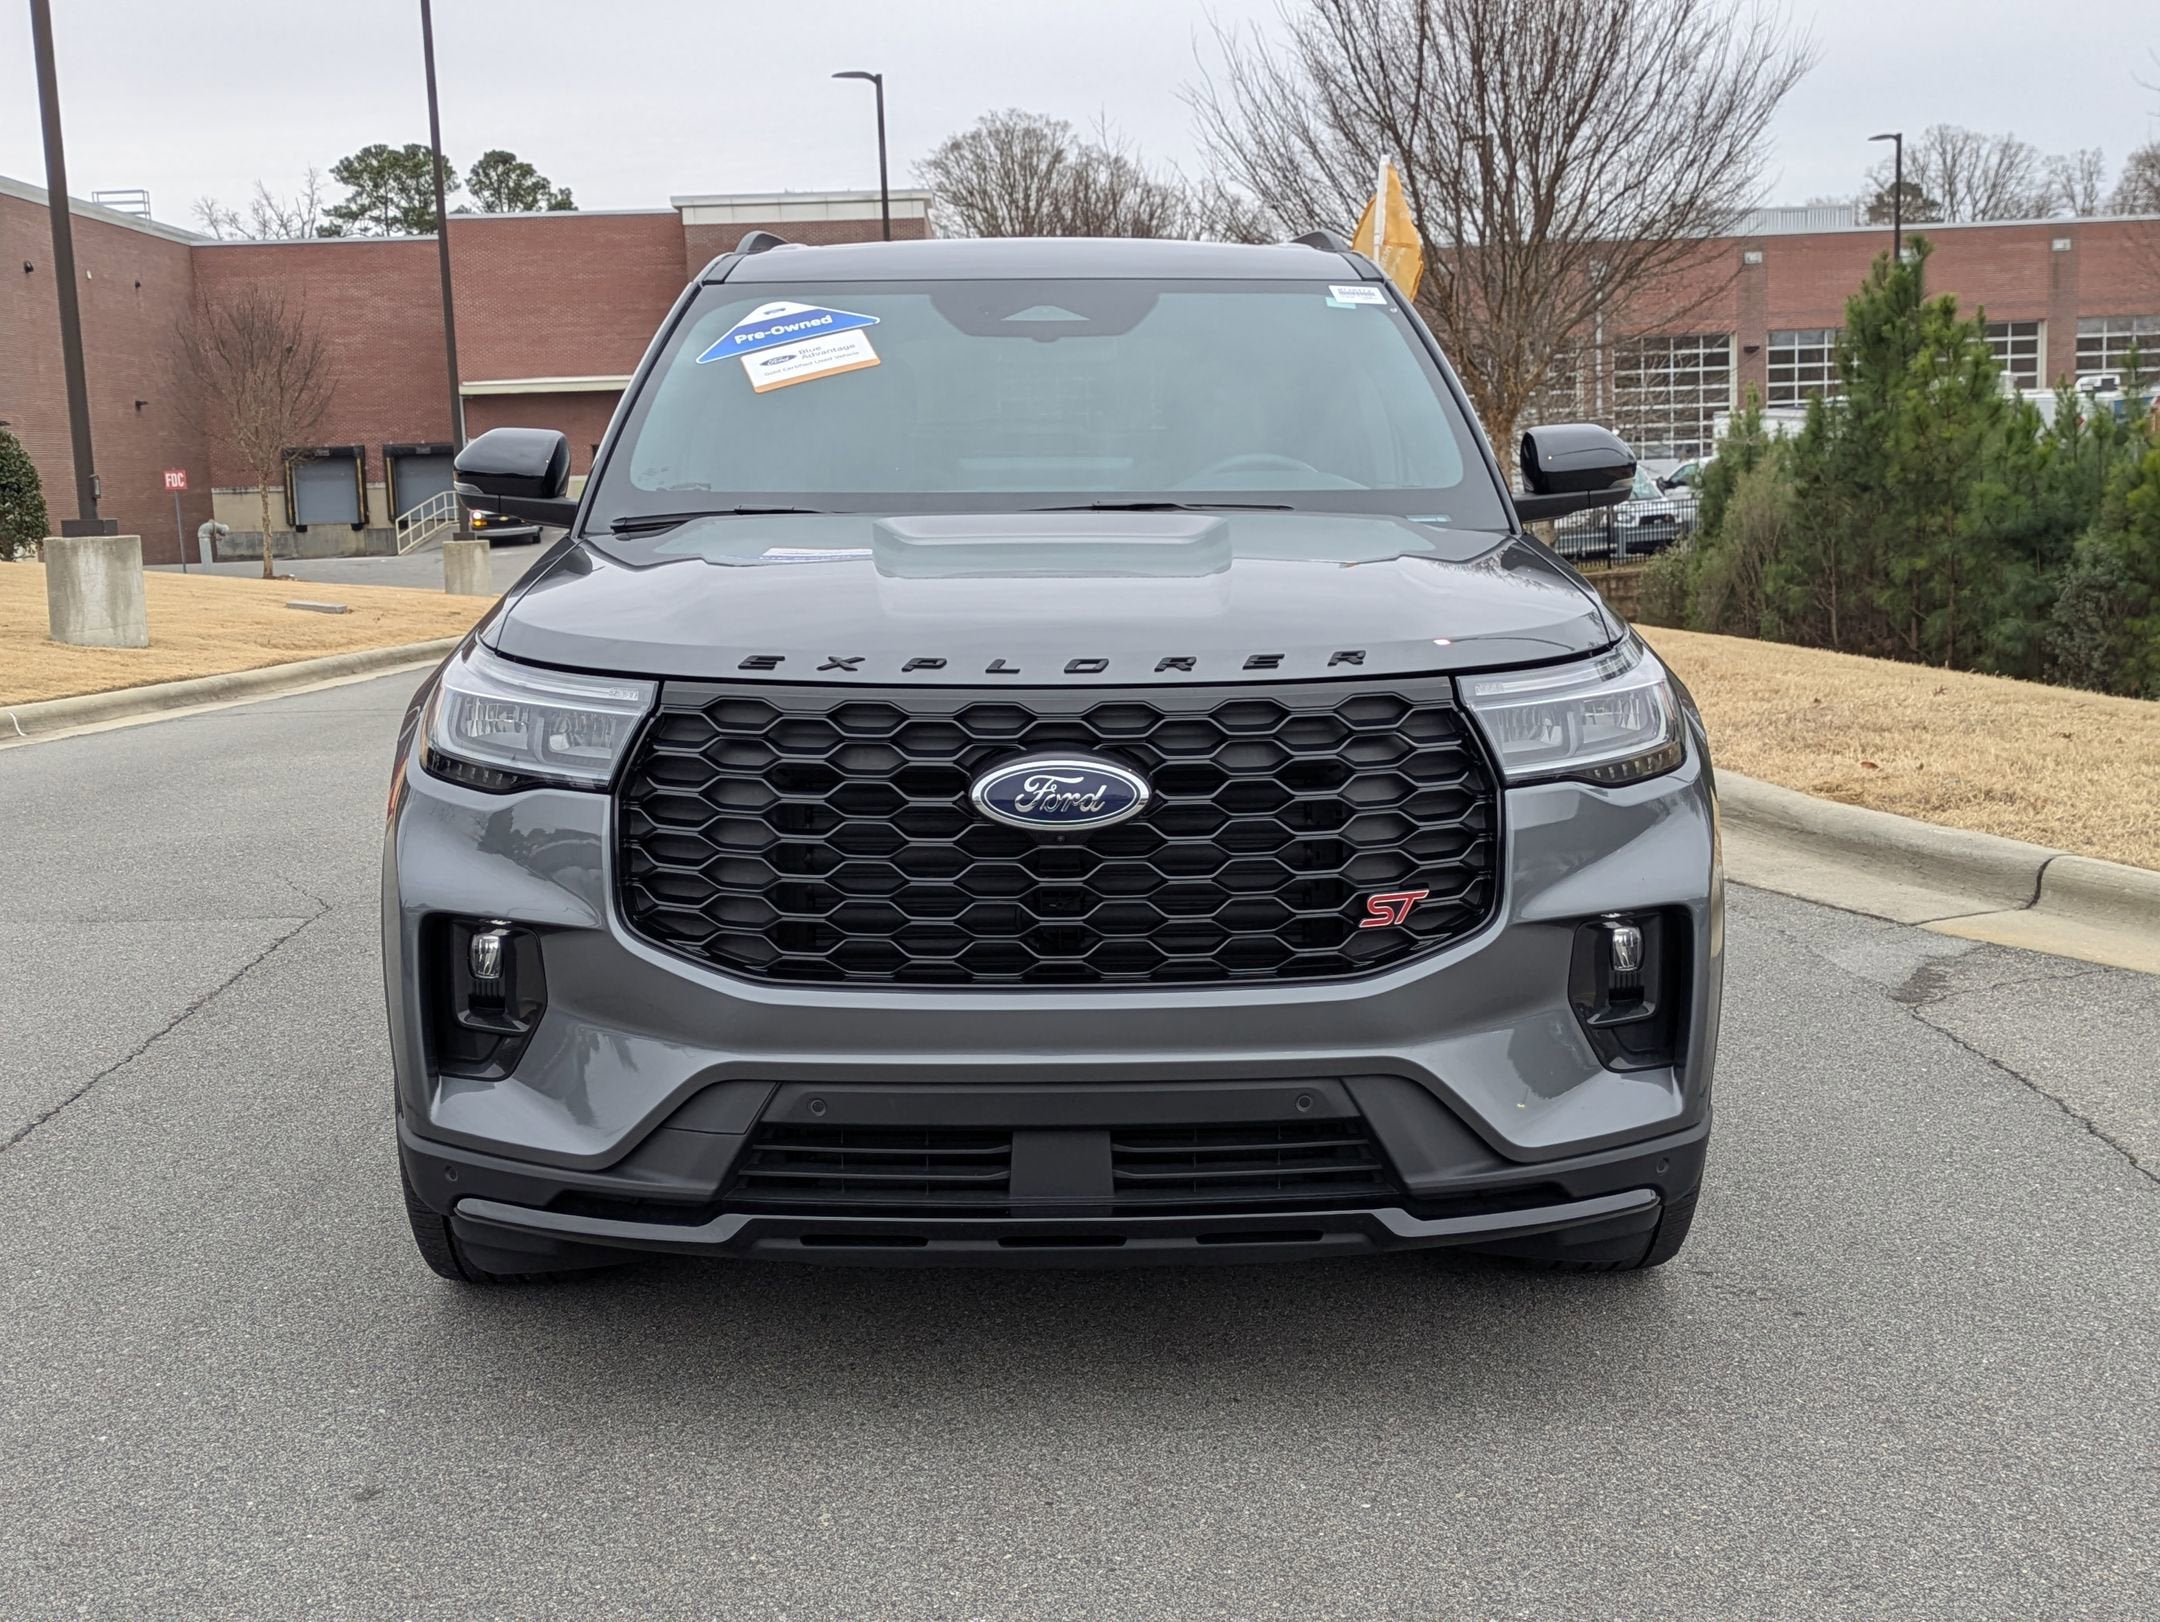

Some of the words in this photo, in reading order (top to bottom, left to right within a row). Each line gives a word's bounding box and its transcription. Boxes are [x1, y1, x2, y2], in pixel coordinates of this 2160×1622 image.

[734, 314, 833, 345] Pre-Owned
[798, 346, 822, 355] Blue
[801, 344, 856, 360] Advantage
[165, 472, 184, 488] FDC
[737, 650, 1366, 674] EXPLORER
[1014, 774, 1108, 813] Ford
[1358, 889, 1430, 928] ST
